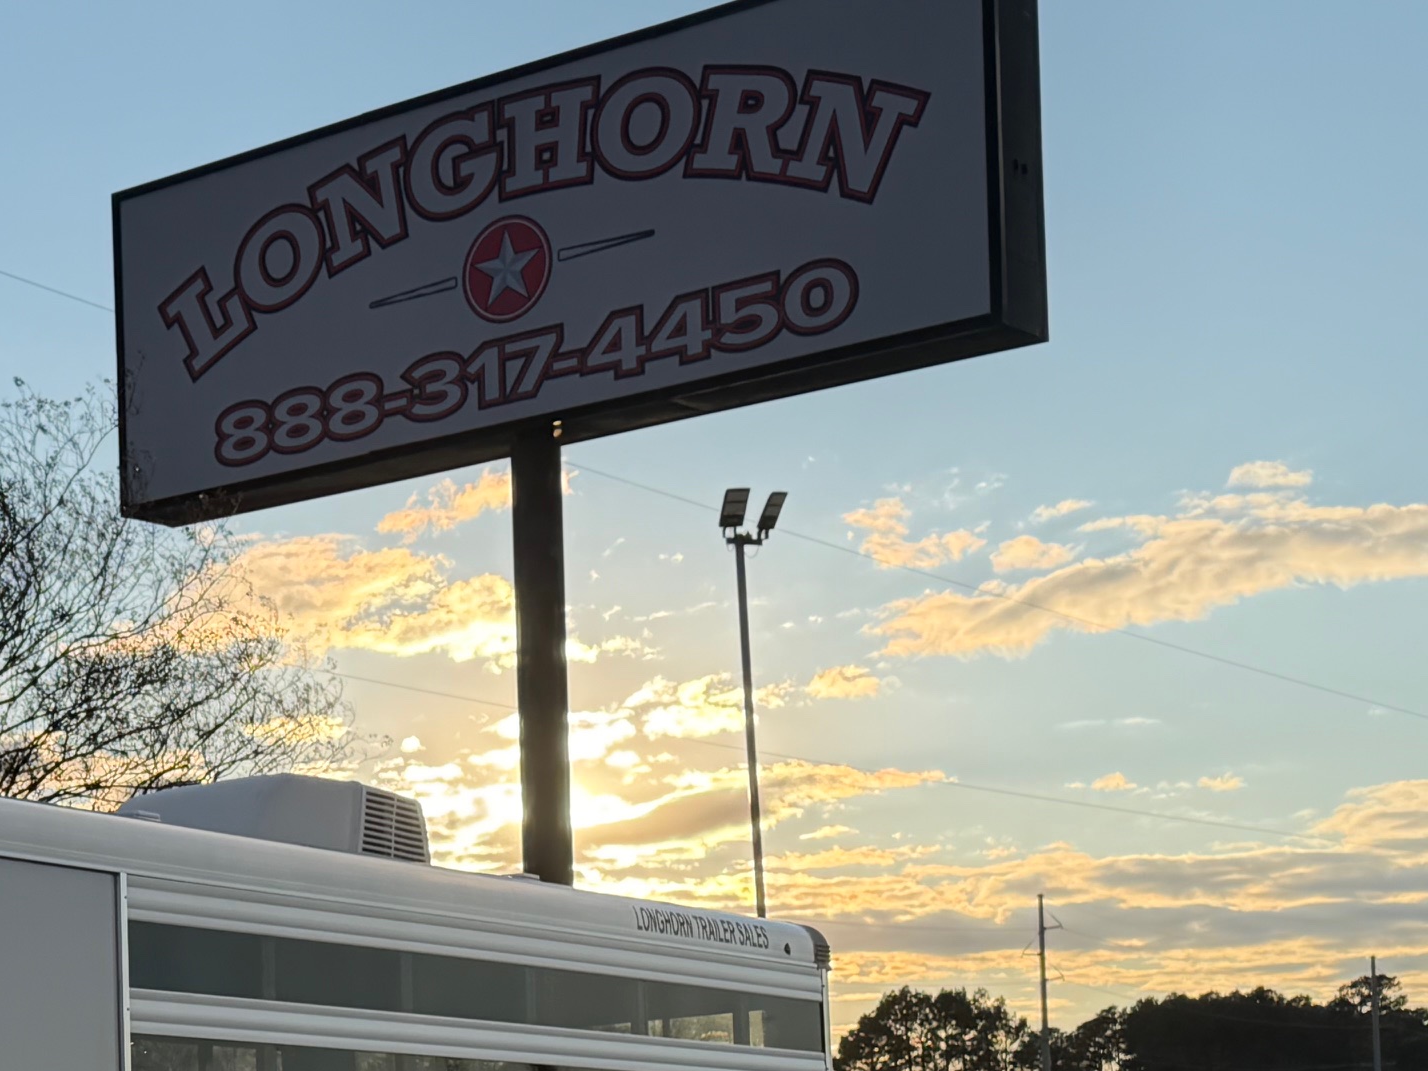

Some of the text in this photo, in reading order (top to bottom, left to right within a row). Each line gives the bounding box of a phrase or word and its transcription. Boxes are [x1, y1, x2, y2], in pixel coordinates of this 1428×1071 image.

[158, 64, 931, 381] LONGHORN
[215, 257, 859, 467] 888-317-4450
[633, 906, 769, 949] LONGHORN TRAILER SALES
